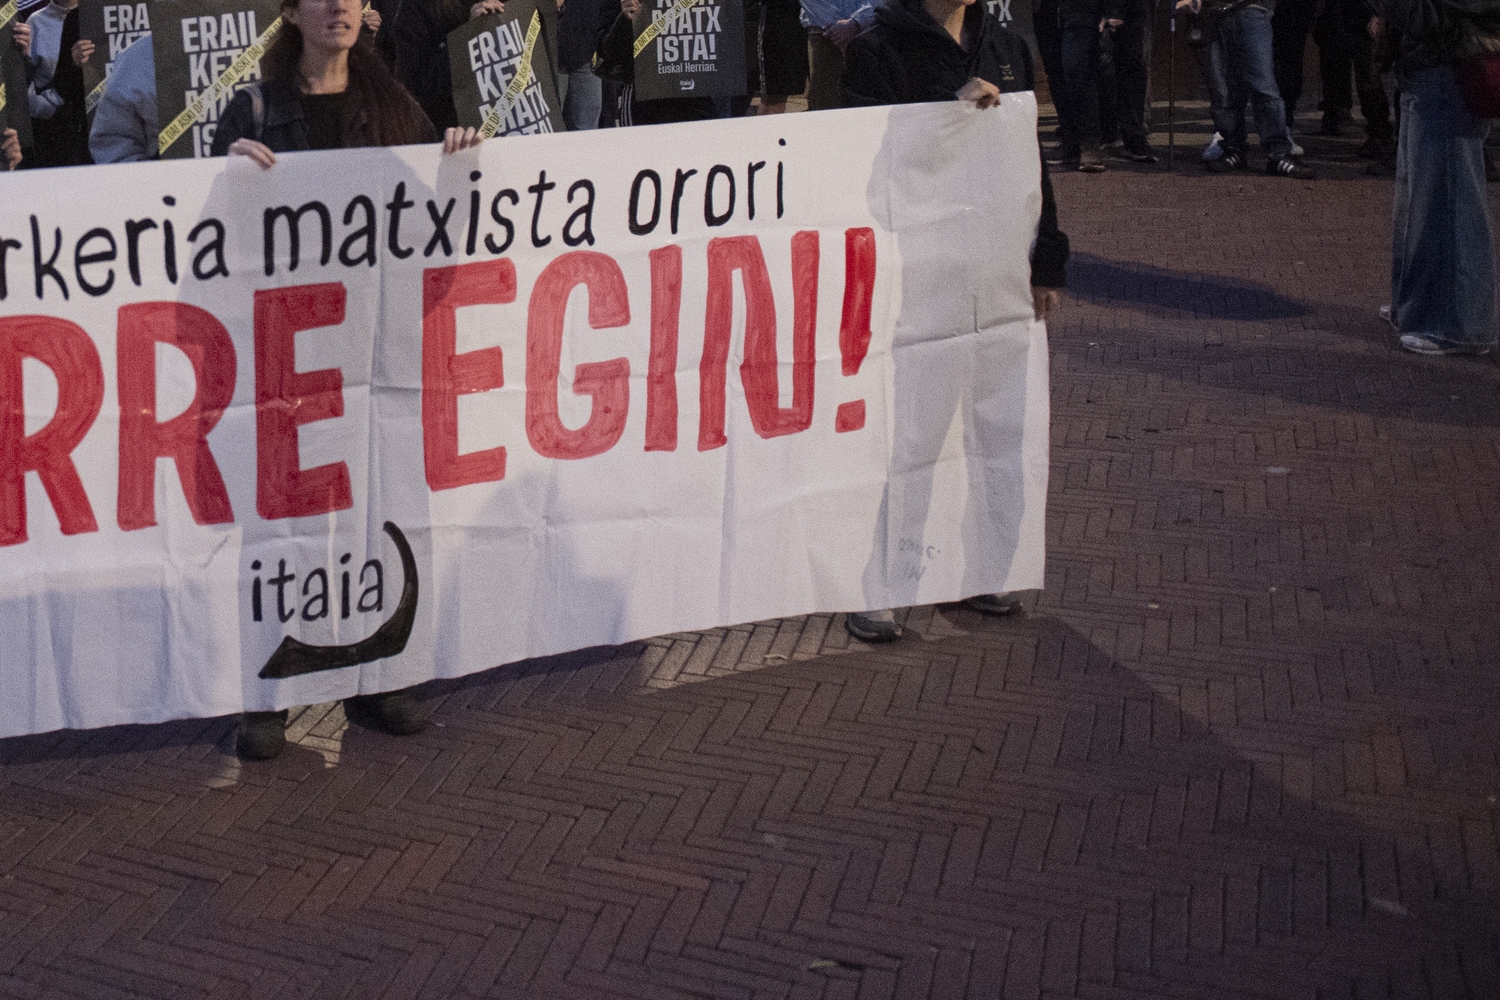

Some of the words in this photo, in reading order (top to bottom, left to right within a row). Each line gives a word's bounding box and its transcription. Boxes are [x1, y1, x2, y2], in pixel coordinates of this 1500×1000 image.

[656, 33, 717, 63] ISTA!
[658, 63, 683, 75] Euskal
[685, 61, 718, 73] Herrian.
[263, 170, 596, 276] matxista
[628, 138, 787, 237] orori
[421, 226, 877, 492] EGIN!
[251, 550, 385, 623] itaia
